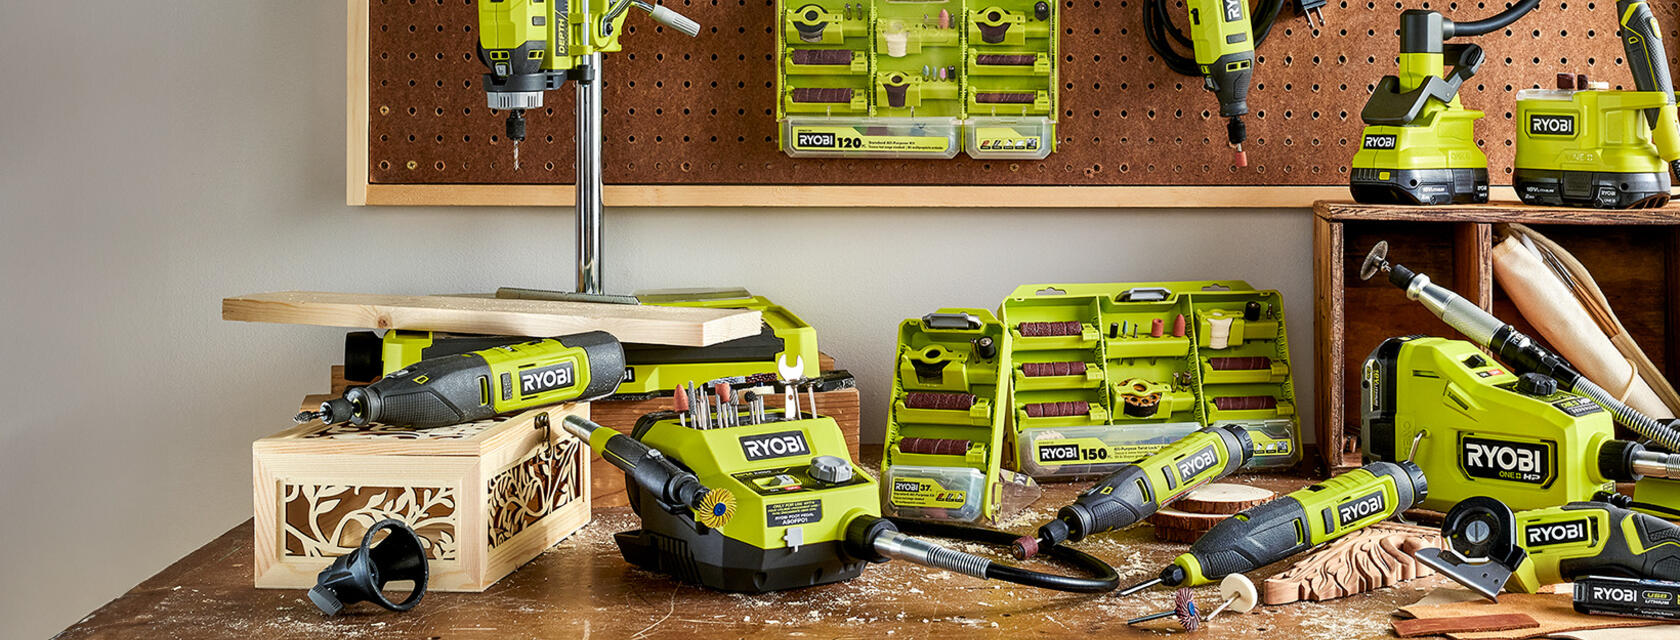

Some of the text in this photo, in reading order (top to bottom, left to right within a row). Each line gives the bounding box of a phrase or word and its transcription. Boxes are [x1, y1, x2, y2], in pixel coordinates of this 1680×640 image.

[1533, 118, 1572, 132] RYOBI
[799, 135, 833, 145] RYOBI
[837, 137, 862, 148] 120
[1365, 136, 1396, 148] RYOBI
[522, 367, 571, 392] RYOBI
[744, 435, 806, 458] RYOBI
[1041, 447, 1078, 460] RYOBI
[1081, 448, 1107, 460] 150
[1179, 449, 1215, 478] RYOBI
[1466, 443, 1541, 473] RYOBI
[895, 483, 918, 492] RYOBI
[1340, 496, 1382, 522] RYOBI
[1528, 523, 1583, 543] RYOBI
[1593, 586, 1638, 602] RYOBI
